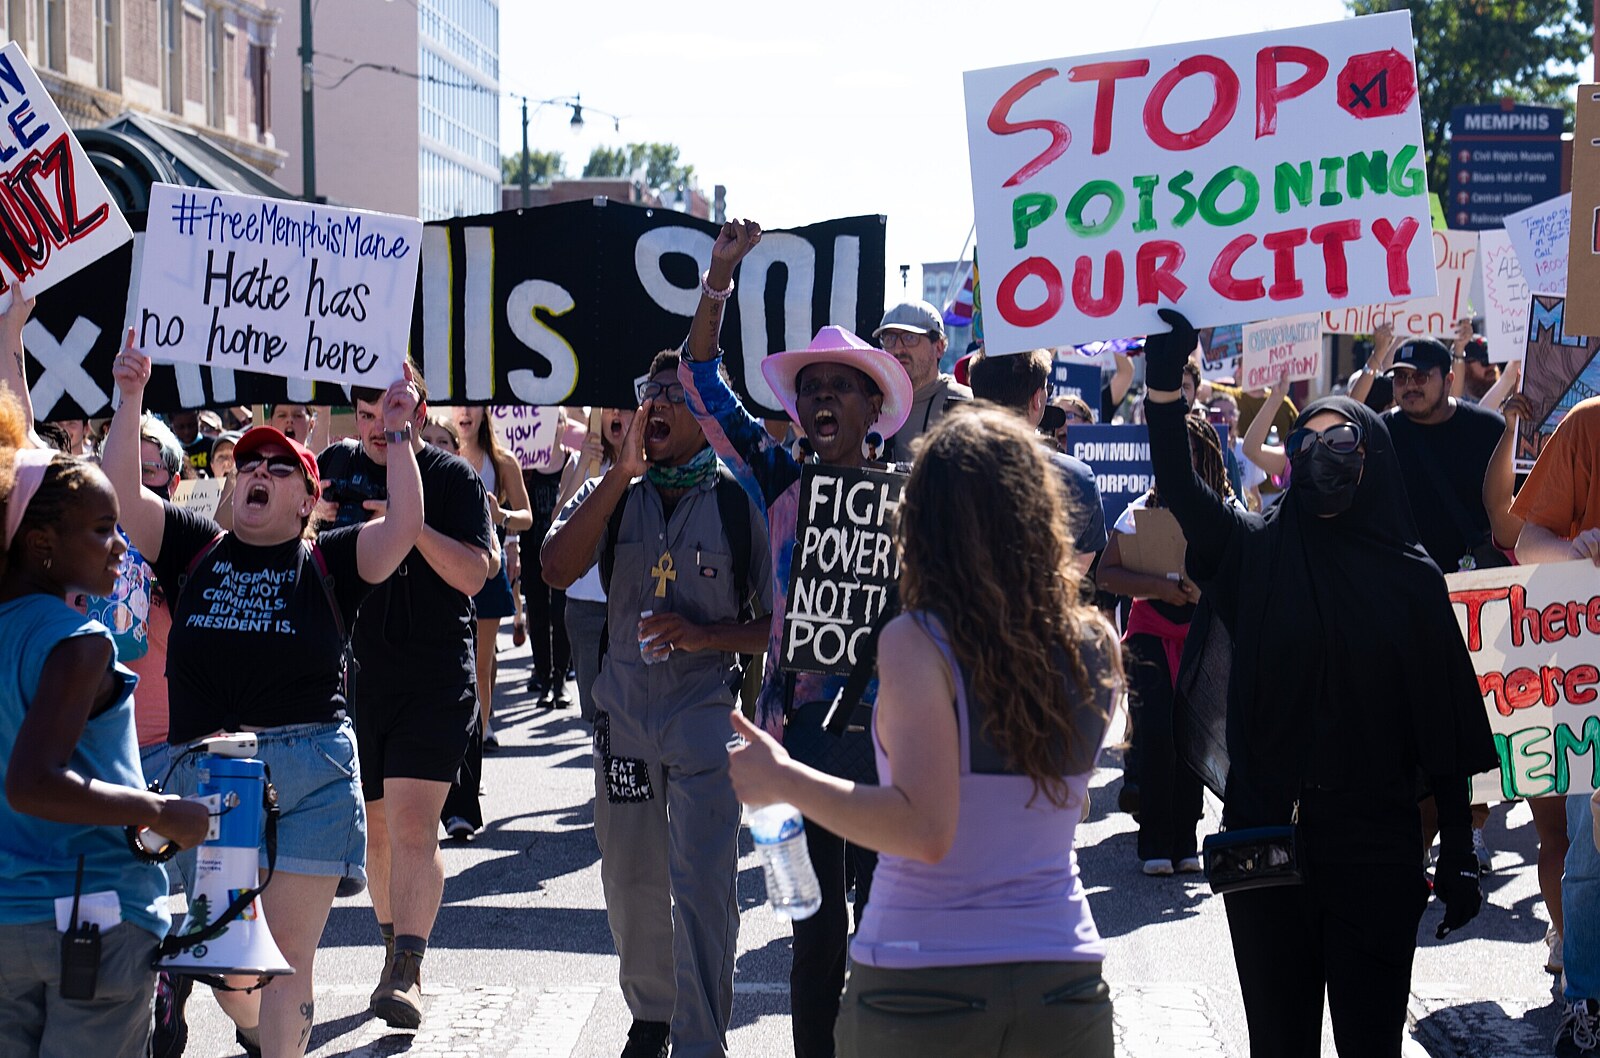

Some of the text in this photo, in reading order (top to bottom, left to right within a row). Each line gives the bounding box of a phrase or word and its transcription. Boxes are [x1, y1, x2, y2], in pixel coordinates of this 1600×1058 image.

[987, 46, 1329, 188] STOP
[1464, 113, 1550, 131] MEMPHIS
[1520, 151, 1555, 161] Museum
[1525, 172, 1547, 182] Fame
[1013, 144, 1425, 249] POISONING
[1503, 192, 1533, 203] Station
[172, 194, 409, 259] #freeMemphisMane
[997, 217, 1419, 328] OUR CITY
[203, 250, 371, 322] Hate has
[140, 306, 379, 373] no home here
[1269, 343, 1295, 364] NOT
[506, 422, 541, 451] your
[1074, 442, 1151, 461] COMMUNI
[1096, 474, 1155, 493] ORPOR
[808, 474, 907, 527] FIGH
[801, 526, 900, 580] POVER
[220, 574, 281, 597] ARE NOT
[793, 577, 860, 620] NOT
[209, 602, 273, 620] BUT THE
[186, 614, 296, 634] PRESIDENT IS.
[611, 759, 635, 774] EAT
[609, 771, 637, 787] THE
